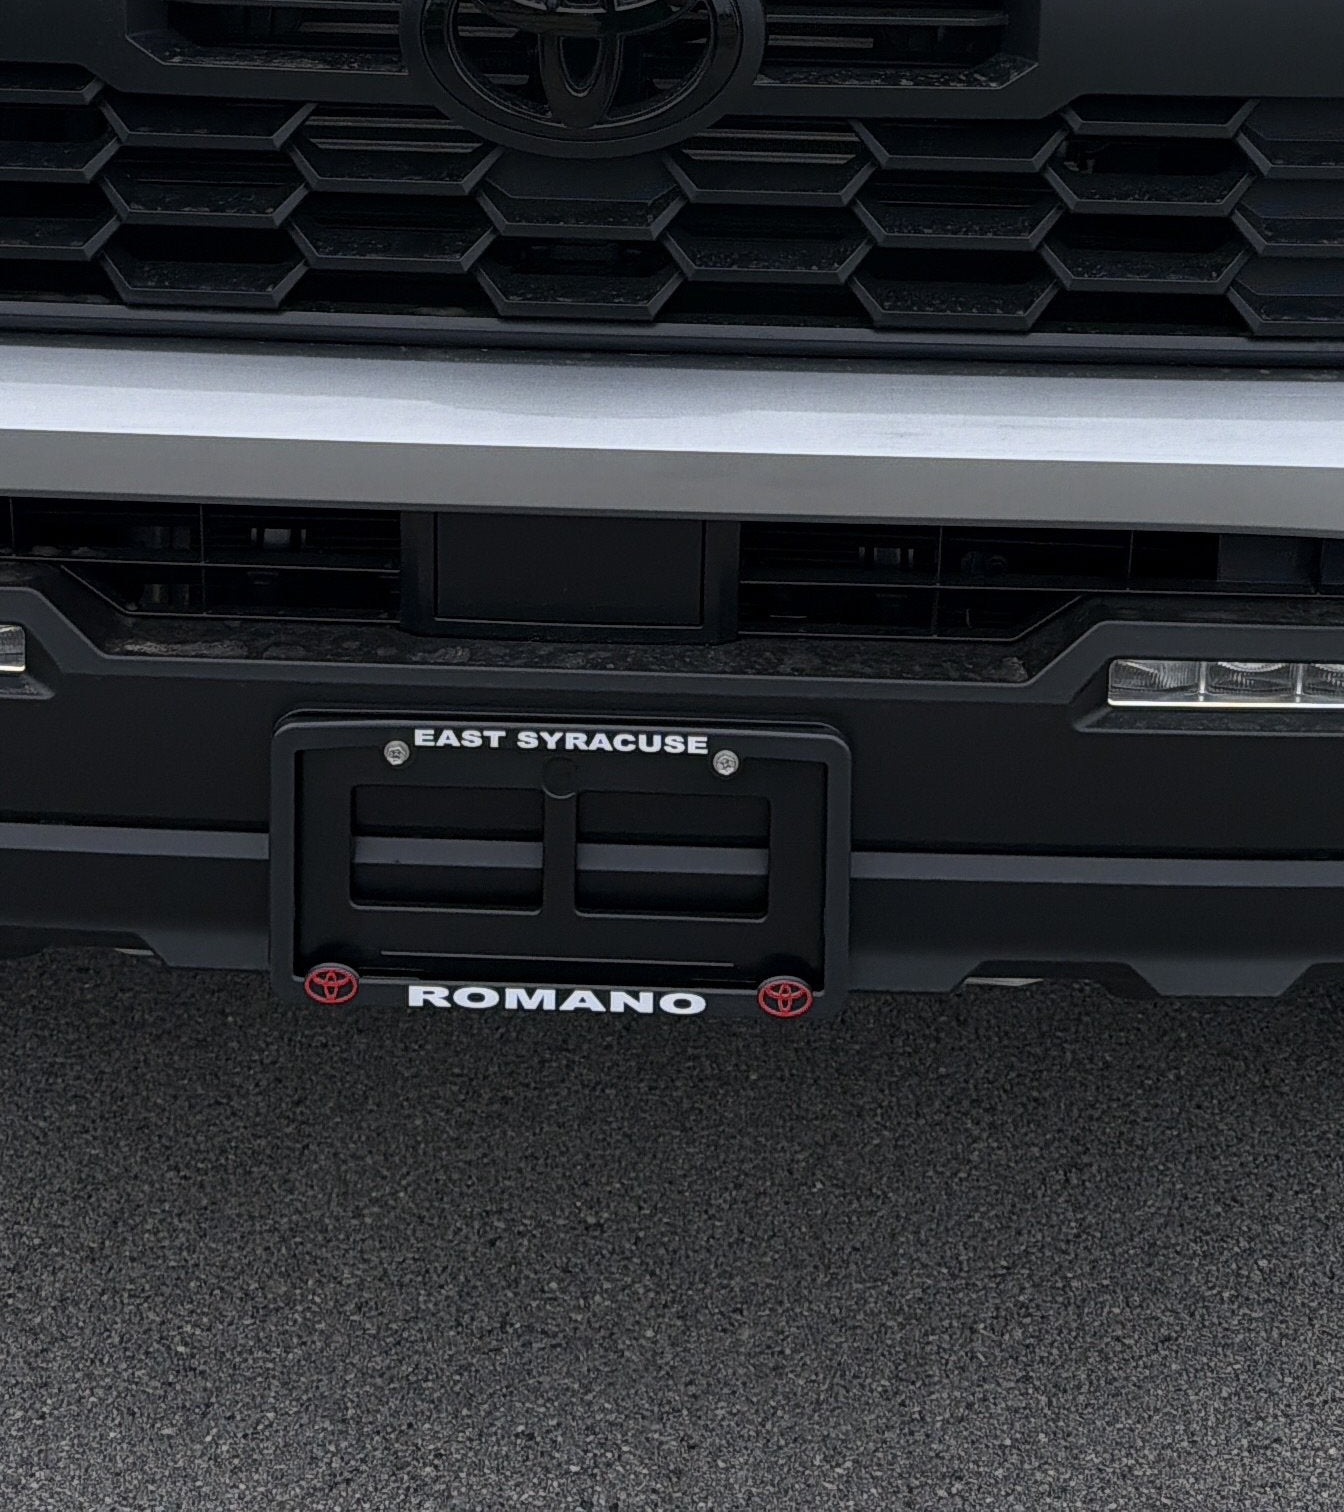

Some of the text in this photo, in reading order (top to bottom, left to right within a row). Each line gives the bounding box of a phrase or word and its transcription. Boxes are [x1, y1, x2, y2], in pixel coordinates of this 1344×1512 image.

[414, 728, 709, 755] EAST SYRACUSE
[408, 985, 707, 1015] ROMANO
